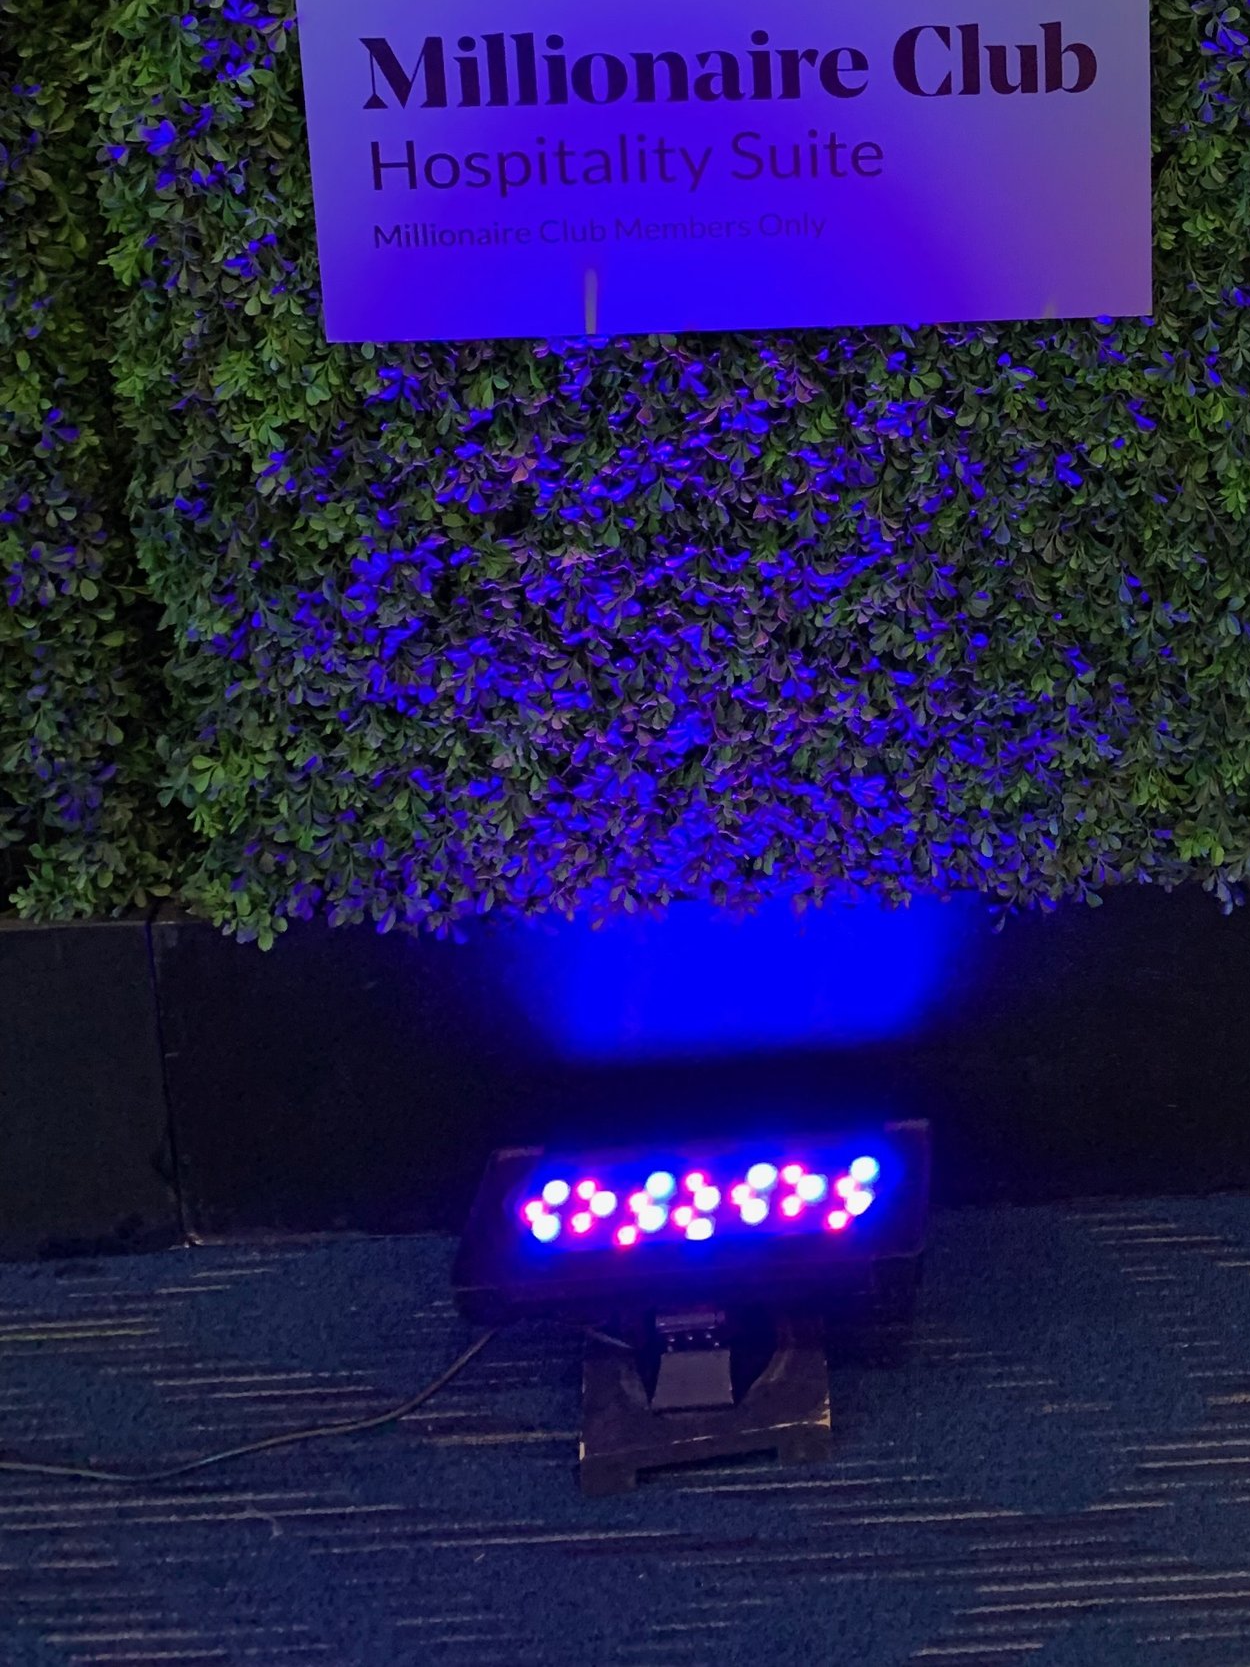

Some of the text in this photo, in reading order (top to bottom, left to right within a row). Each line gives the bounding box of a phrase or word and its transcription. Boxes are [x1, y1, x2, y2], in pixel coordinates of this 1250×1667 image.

[358, 21, 1098, 110] Millionaire Club
[370, 129, 884, 199] Hospitality Suite
[373, 211, 828, 249] Millionaire Club Members Only
